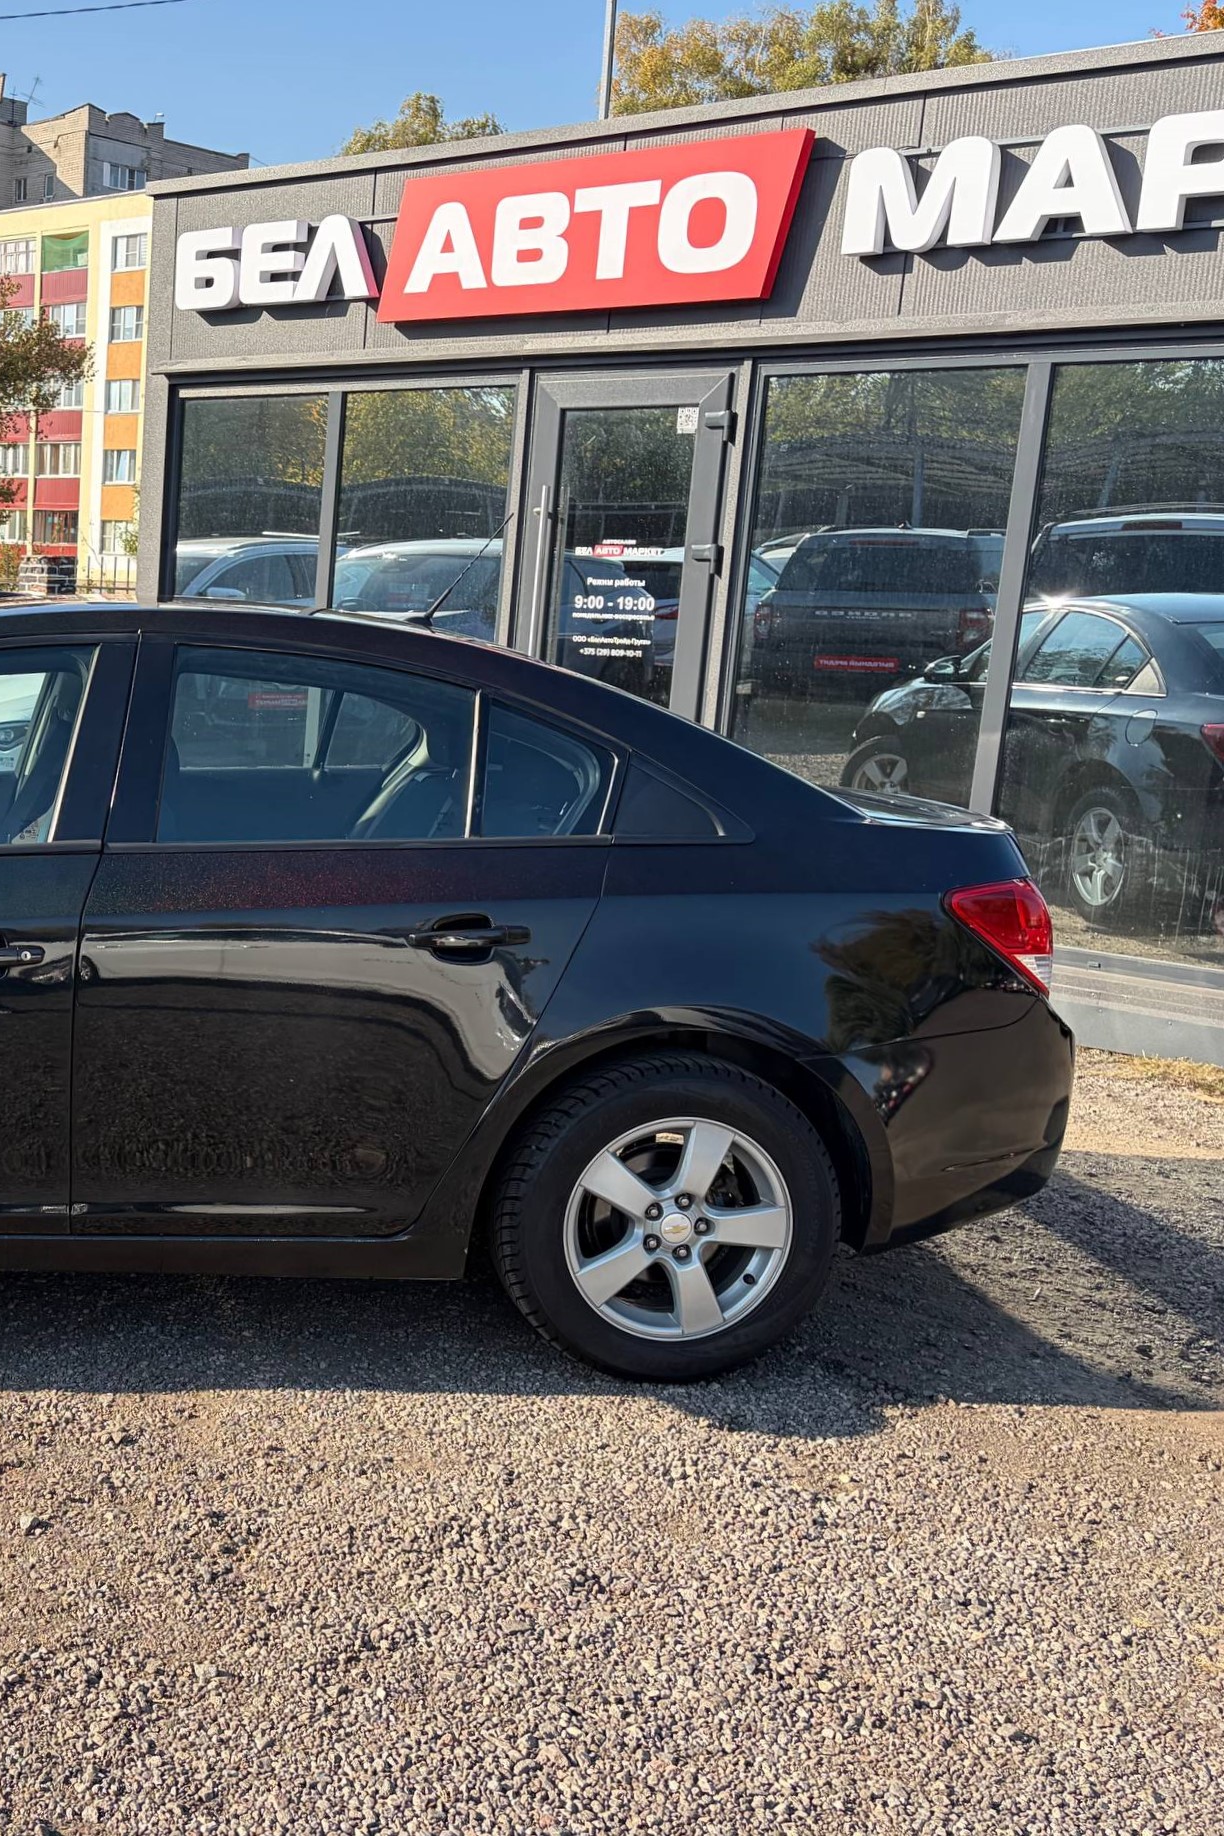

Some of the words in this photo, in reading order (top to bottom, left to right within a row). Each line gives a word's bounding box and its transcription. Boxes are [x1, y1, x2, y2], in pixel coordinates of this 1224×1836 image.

[175, 213, 380, 311] БЕЛ
[403, 171, 758, 294] АВТО
[596, 546, 621, 555] АВТО
[623, 547, 662, 556] МАРКЕТ
[587, 577, 614, 586] Режим
[614, 577, 646, 588] работы
[574, 595, 605, 610] 9:00
[617, 596, 655, 611] 19:00
[579, 647, 596, 656] +375
